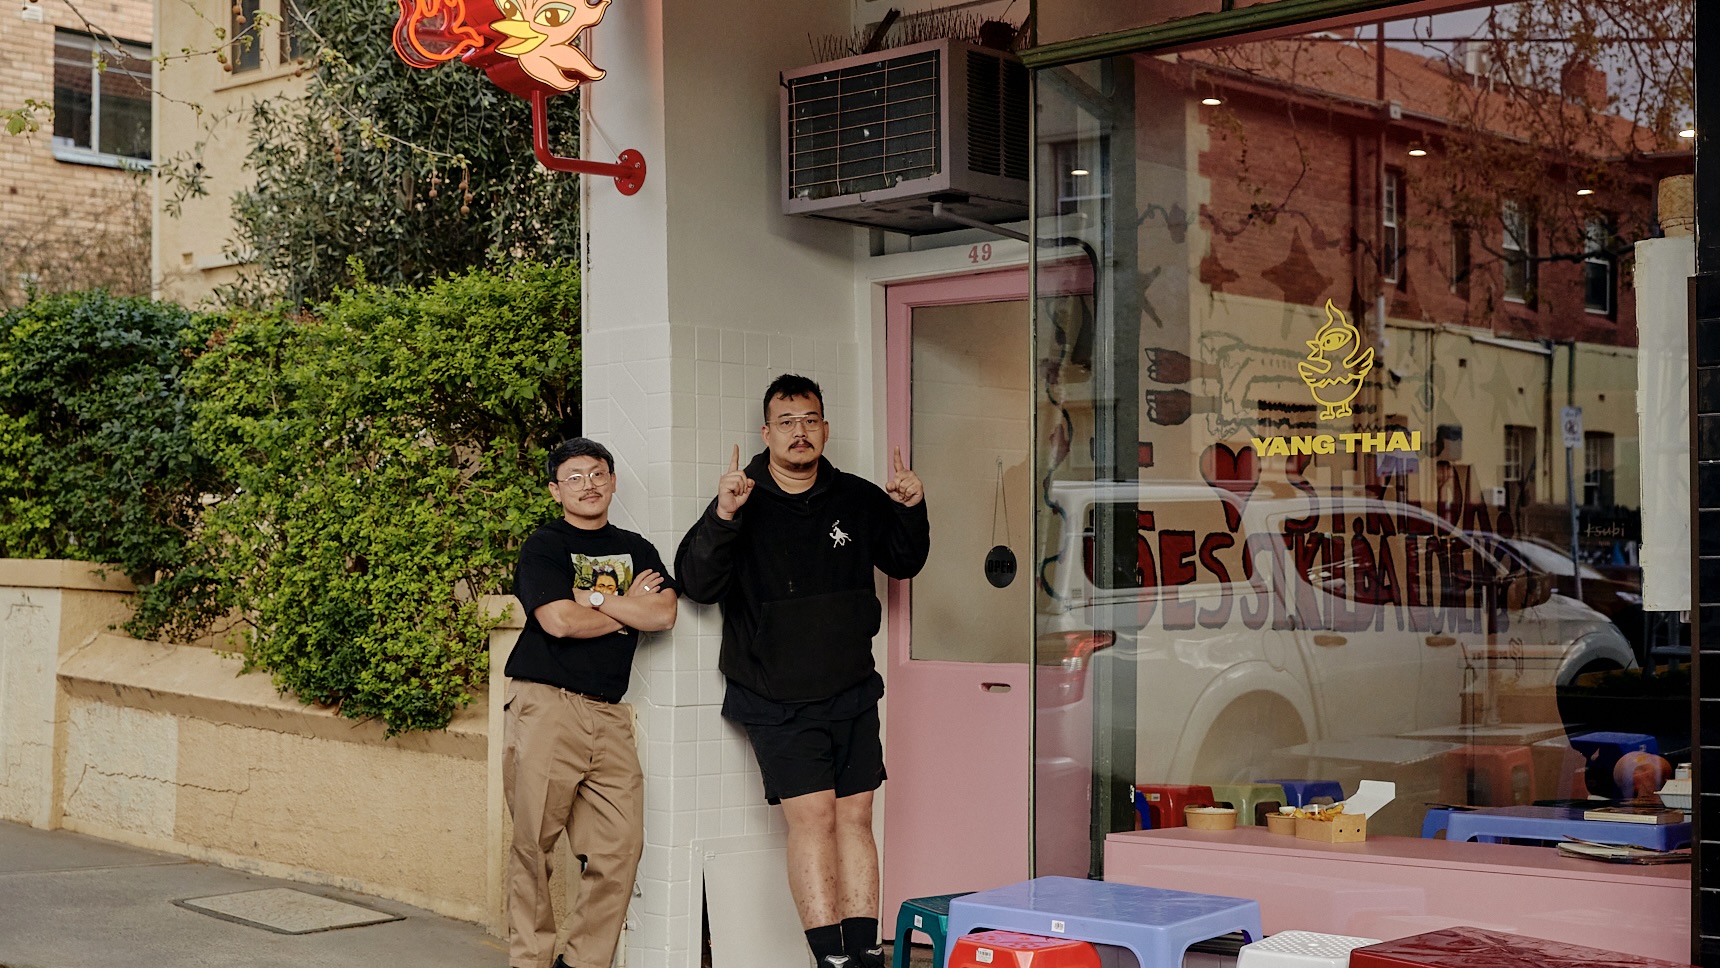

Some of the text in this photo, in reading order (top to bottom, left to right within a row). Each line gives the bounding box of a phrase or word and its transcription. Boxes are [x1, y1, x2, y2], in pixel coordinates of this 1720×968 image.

[968, 243, 992, 263] 49
[1250, 431, 1421, 457] YANG THAI
[987, 559, 1014, 574] OPEN
